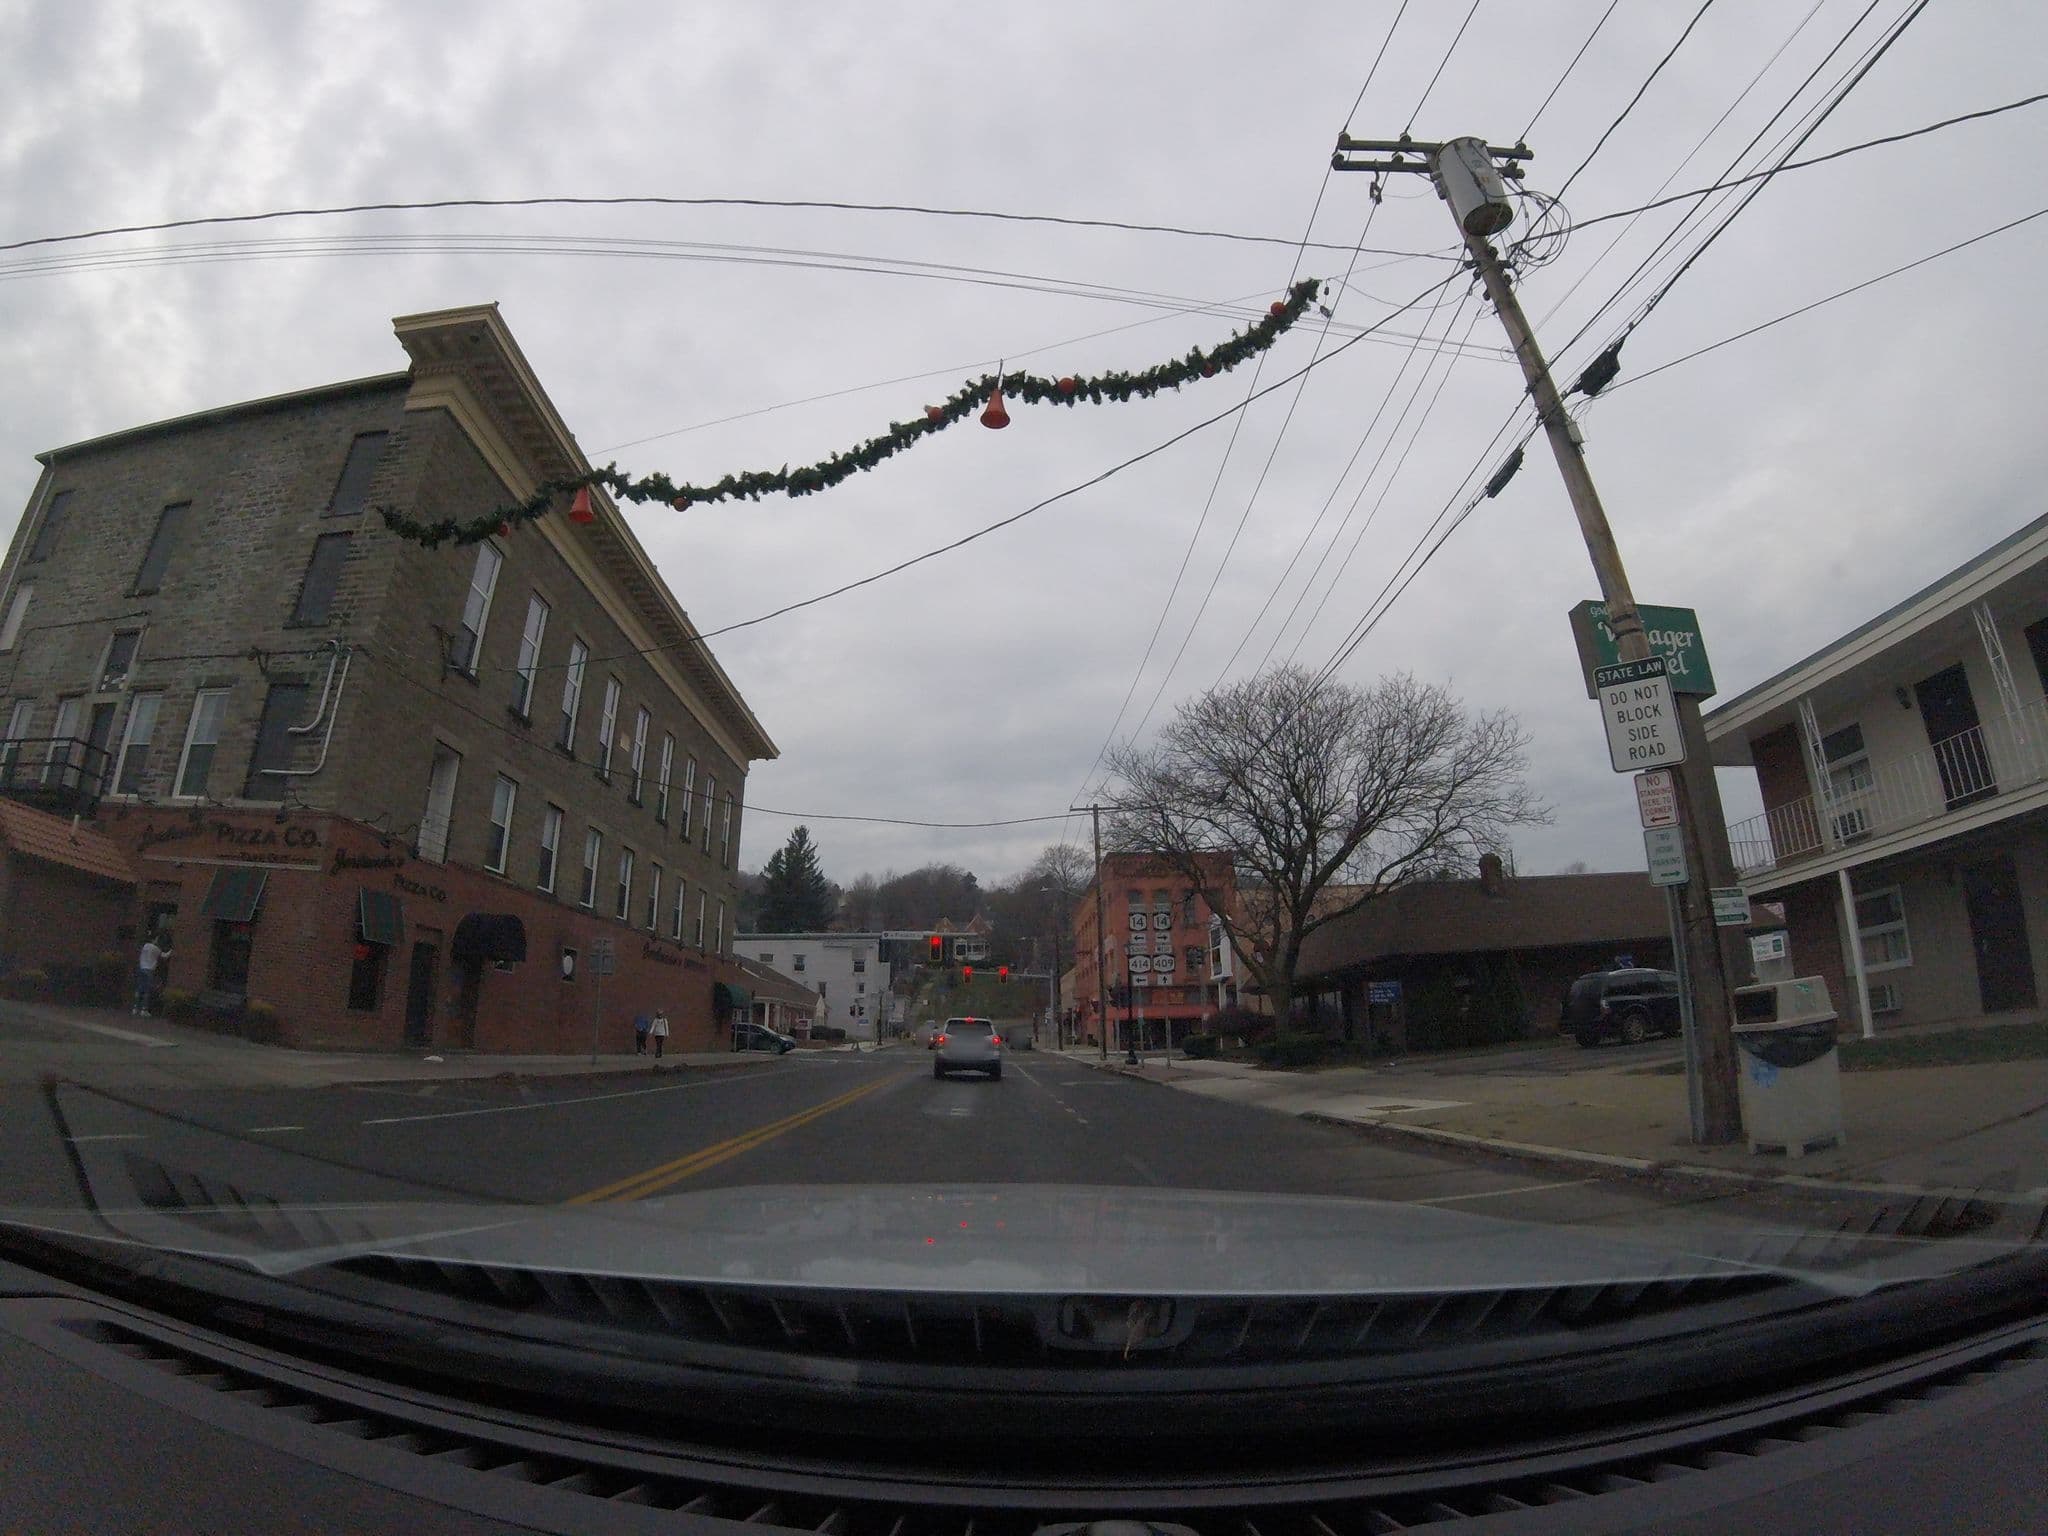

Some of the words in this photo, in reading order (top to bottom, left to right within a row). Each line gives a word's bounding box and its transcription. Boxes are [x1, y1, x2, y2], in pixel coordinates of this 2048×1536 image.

[1598, 666, 1634, 683] STATE
[1638, 661, 1662, 675] LAW
[1610, 690, 1627, 705] DO
[1634, 684, 1660, 700] NOT
[1617, 703, 1663, 723] BLOCK
[1628, 724, 1660, 742] SIDE
[1628, 742, 1666, 760] ROAD
[1646, 775, 1661, 786] NO
[1640, 787, 1673, 798] STANDING
[1642, 798, 1662, 807] HERE
[1662, 796, 1672, 804] TO
[1645, 805, 1673, 816] CORNER
[1132, 916, 1144, 928] 14
[1156, 916, 1168, 927] 14
[1131, 959, 1149, 969] 414
[1155, 959, 1174, 968] 409
